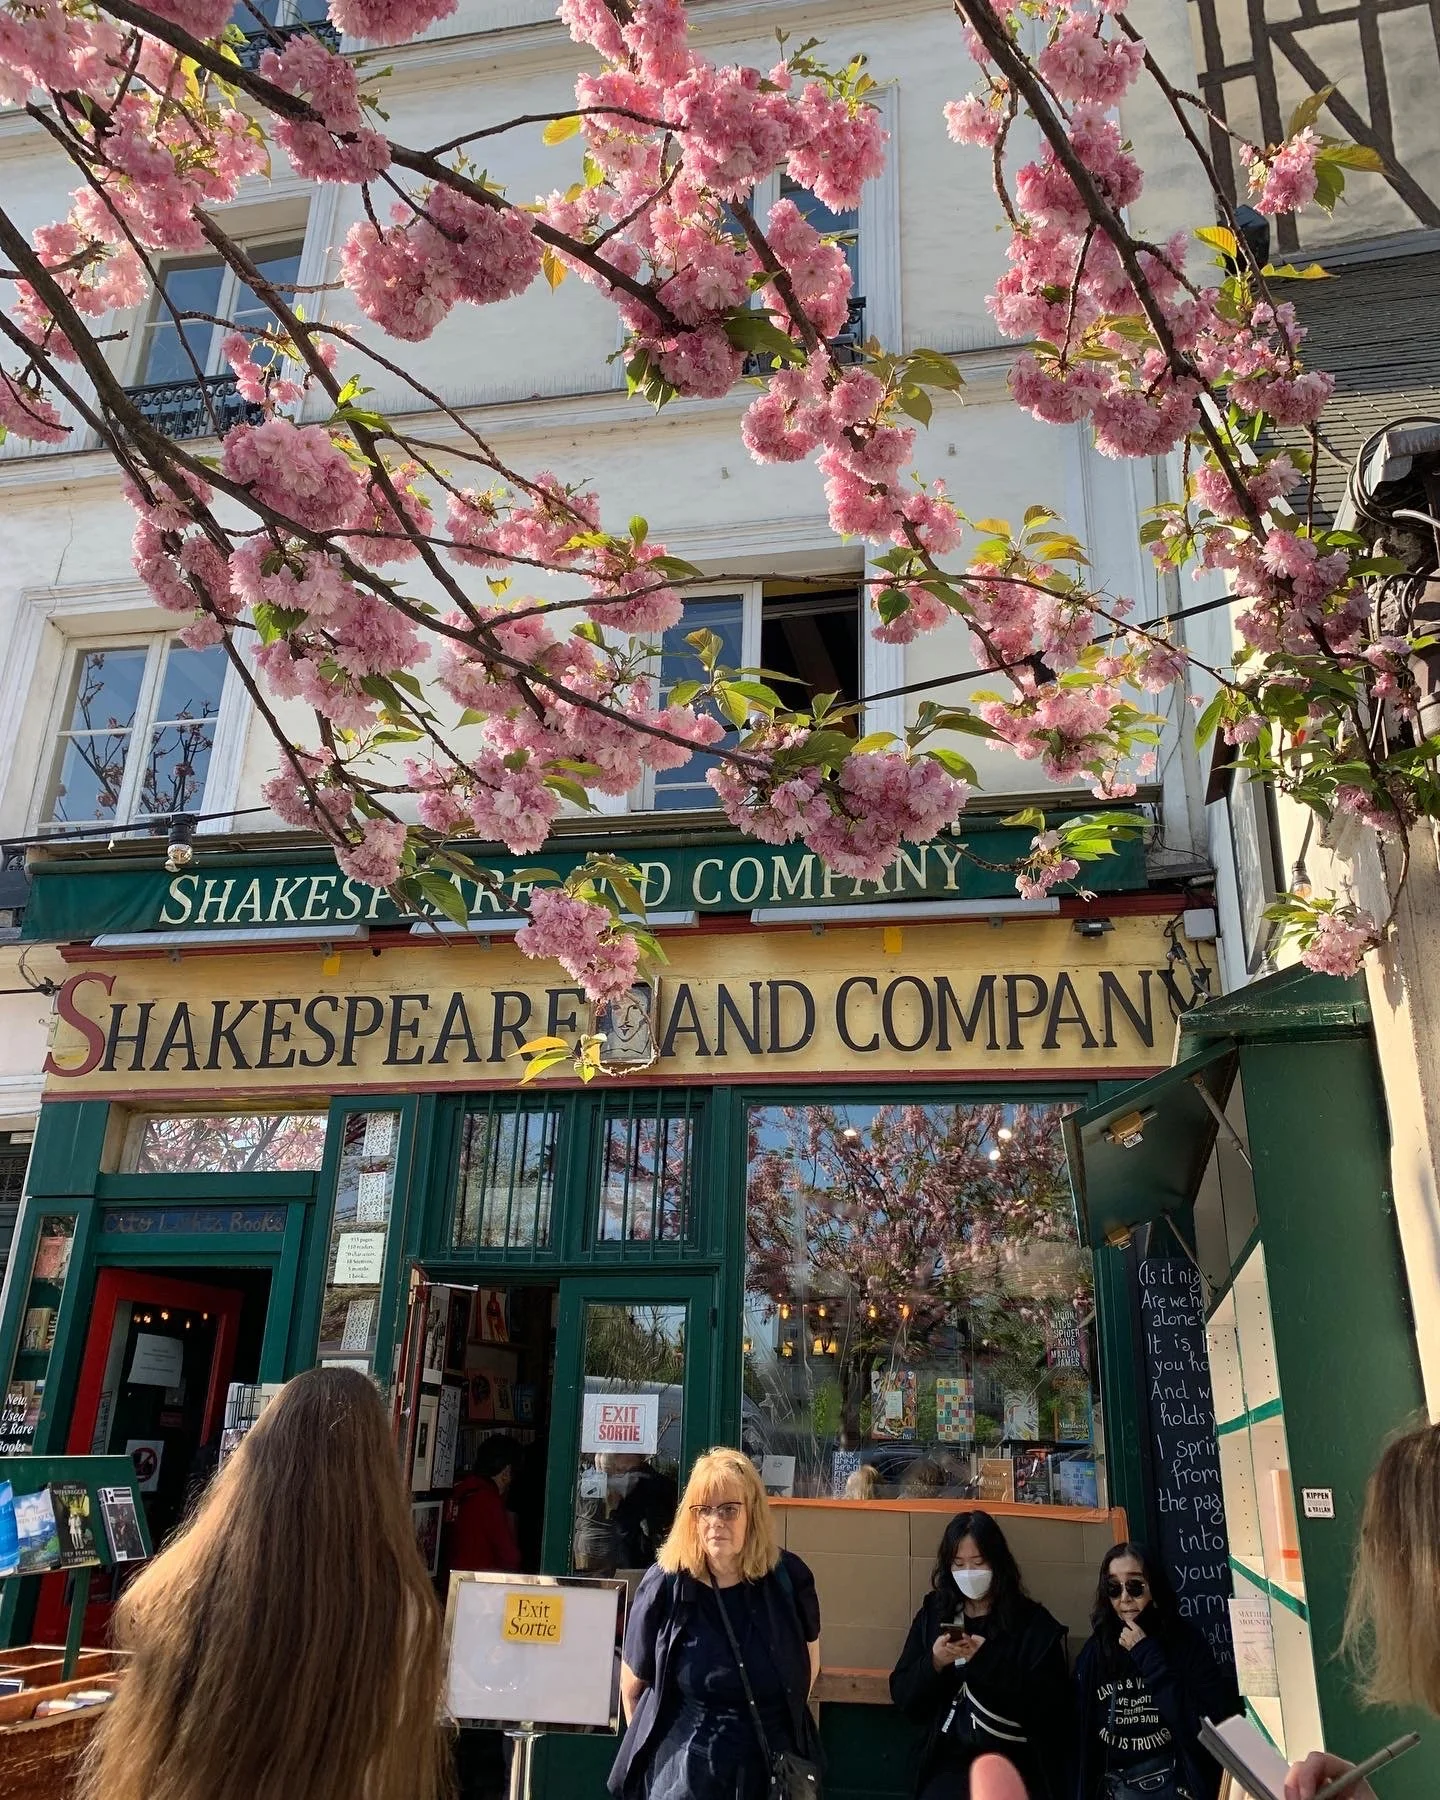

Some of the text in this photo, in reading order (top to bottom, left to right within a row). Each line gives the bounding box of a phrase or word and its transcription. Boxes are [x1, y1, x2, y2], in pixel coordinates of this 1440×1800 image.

[43, 968, 1212, 1077] SHAKESPEARE AND COMPANY
[1161, 1262, 1174, 1285] it
[1141, 1288, 1167, 1309] Are
[1169, 1295, 1189, 1307] we
[1054, 1328, 1080, 1339] SPIDER
[1058, 1337, 1075, 1347] KING
[1147, 1332, 1163, 1355] It
[1174, 1333, 1191, 1352] is
[1051, 1350, 1080, 1359] MARLON
[1056, 1358, 1080, 1367] JAMES
[1152, 1360, 1184, 1380] you
[1151, 1379, 1190, 1400] And
[5, 1393, 28, 1408] New,
[1, 1409, 27, 1422] Used
[602, 1405, 639, 1423] EXIT
[1160, 1402, 1205, 1427] holds
[0, 1422, 34, 1435] & Rare
[598, 1424, 640, 1442] SORTIE
[1156, 1434, 1164, 1460] I
[1171, 1459, 1220, 1490] from
[1158, 1487, 1188, 1513] the
[1306, 1492, 1329, 1500] KIPPEN
[1179, 1524, 1225, 1553] into
[1174, 1562, 1227, 1593] your
[517, 1599, 551, 1618] Exit
[508, 1617, 557, 1637] Sortie
[1126, 1678, 1133, 1689] &
[1118, 1736, 1129, 1750] IS
[1131, 1731, 1165, 1751] TRUTH
